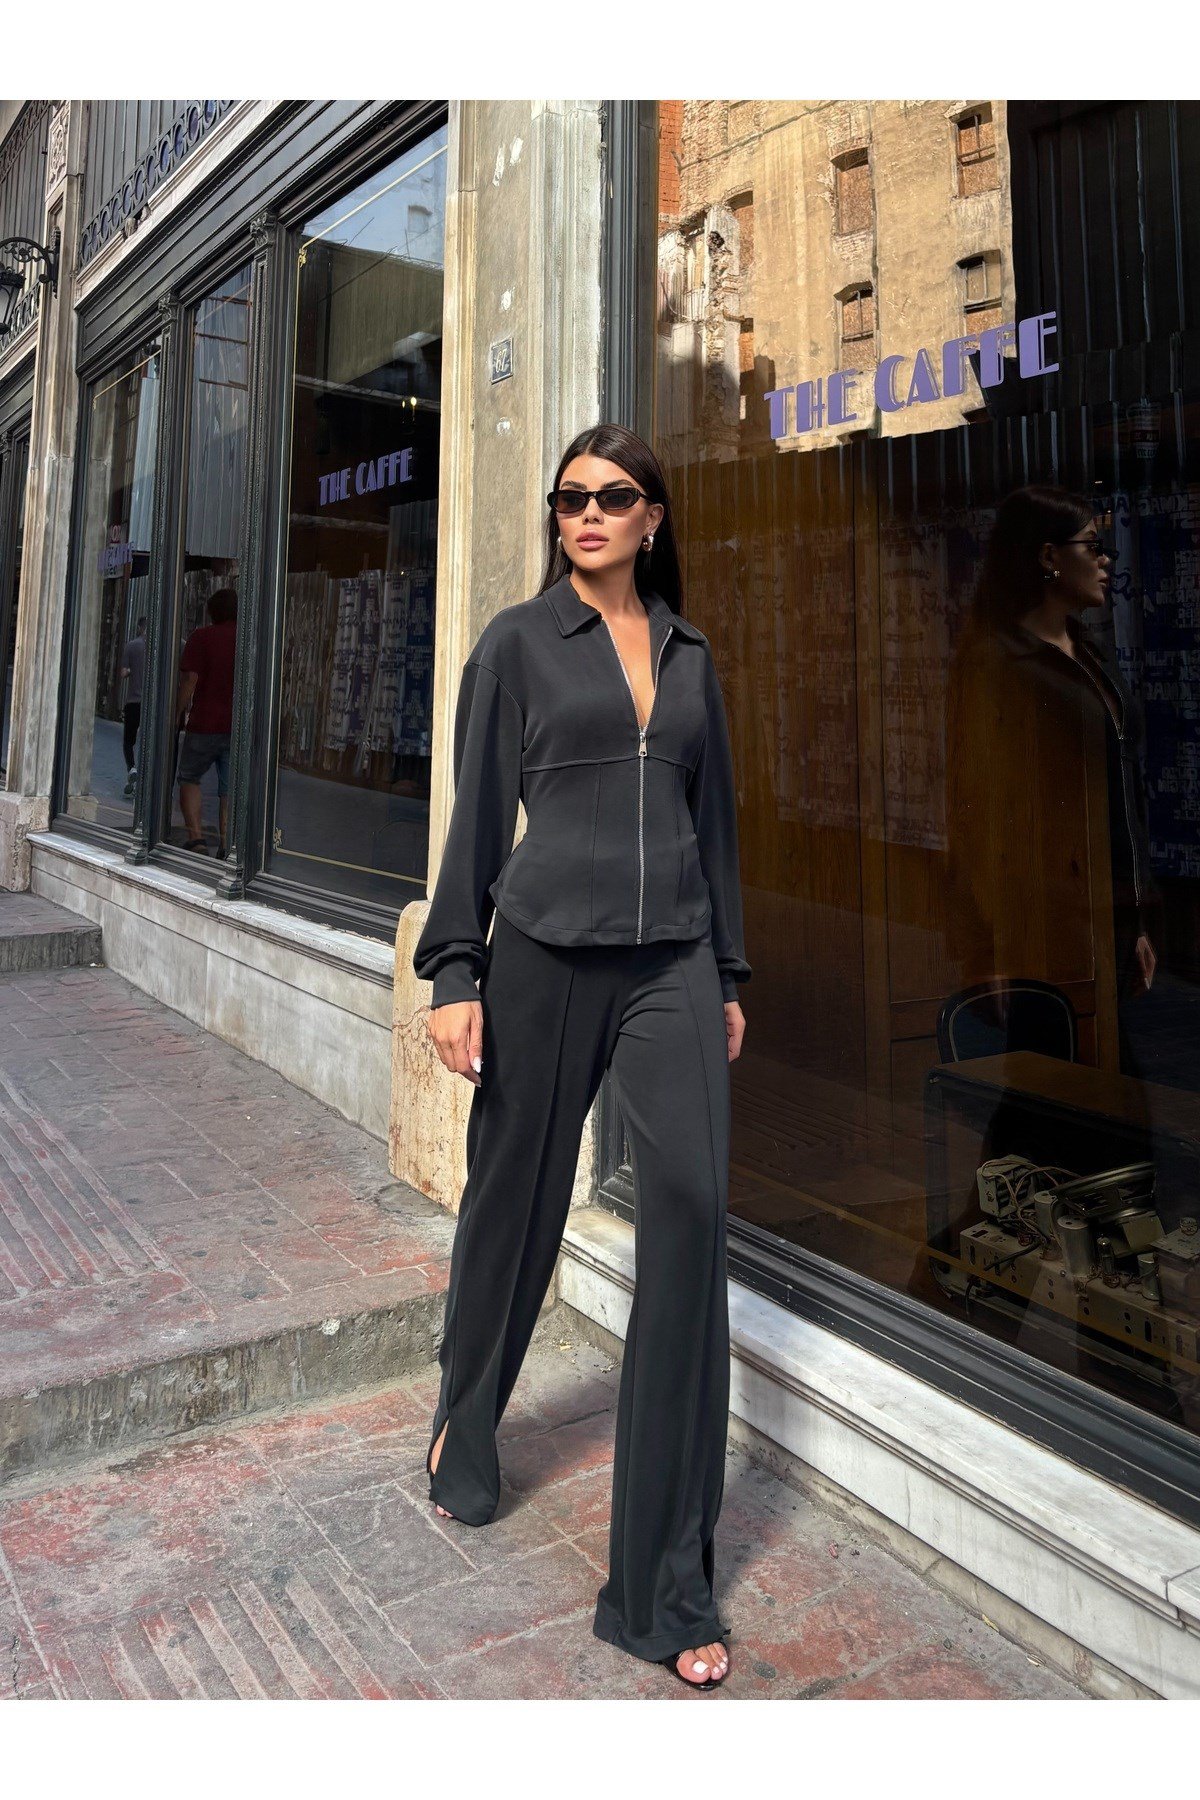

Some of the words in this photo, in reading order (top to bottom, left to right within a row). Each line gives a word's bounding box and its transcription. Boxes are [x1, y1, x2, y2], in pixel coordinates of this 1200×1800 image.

[763, 367, 858, 440] THE
[873, 311, 1060, 413] CAFFE
[318, 467, 351, 506] THE
[355, 446, 413, 496] CAFFE
